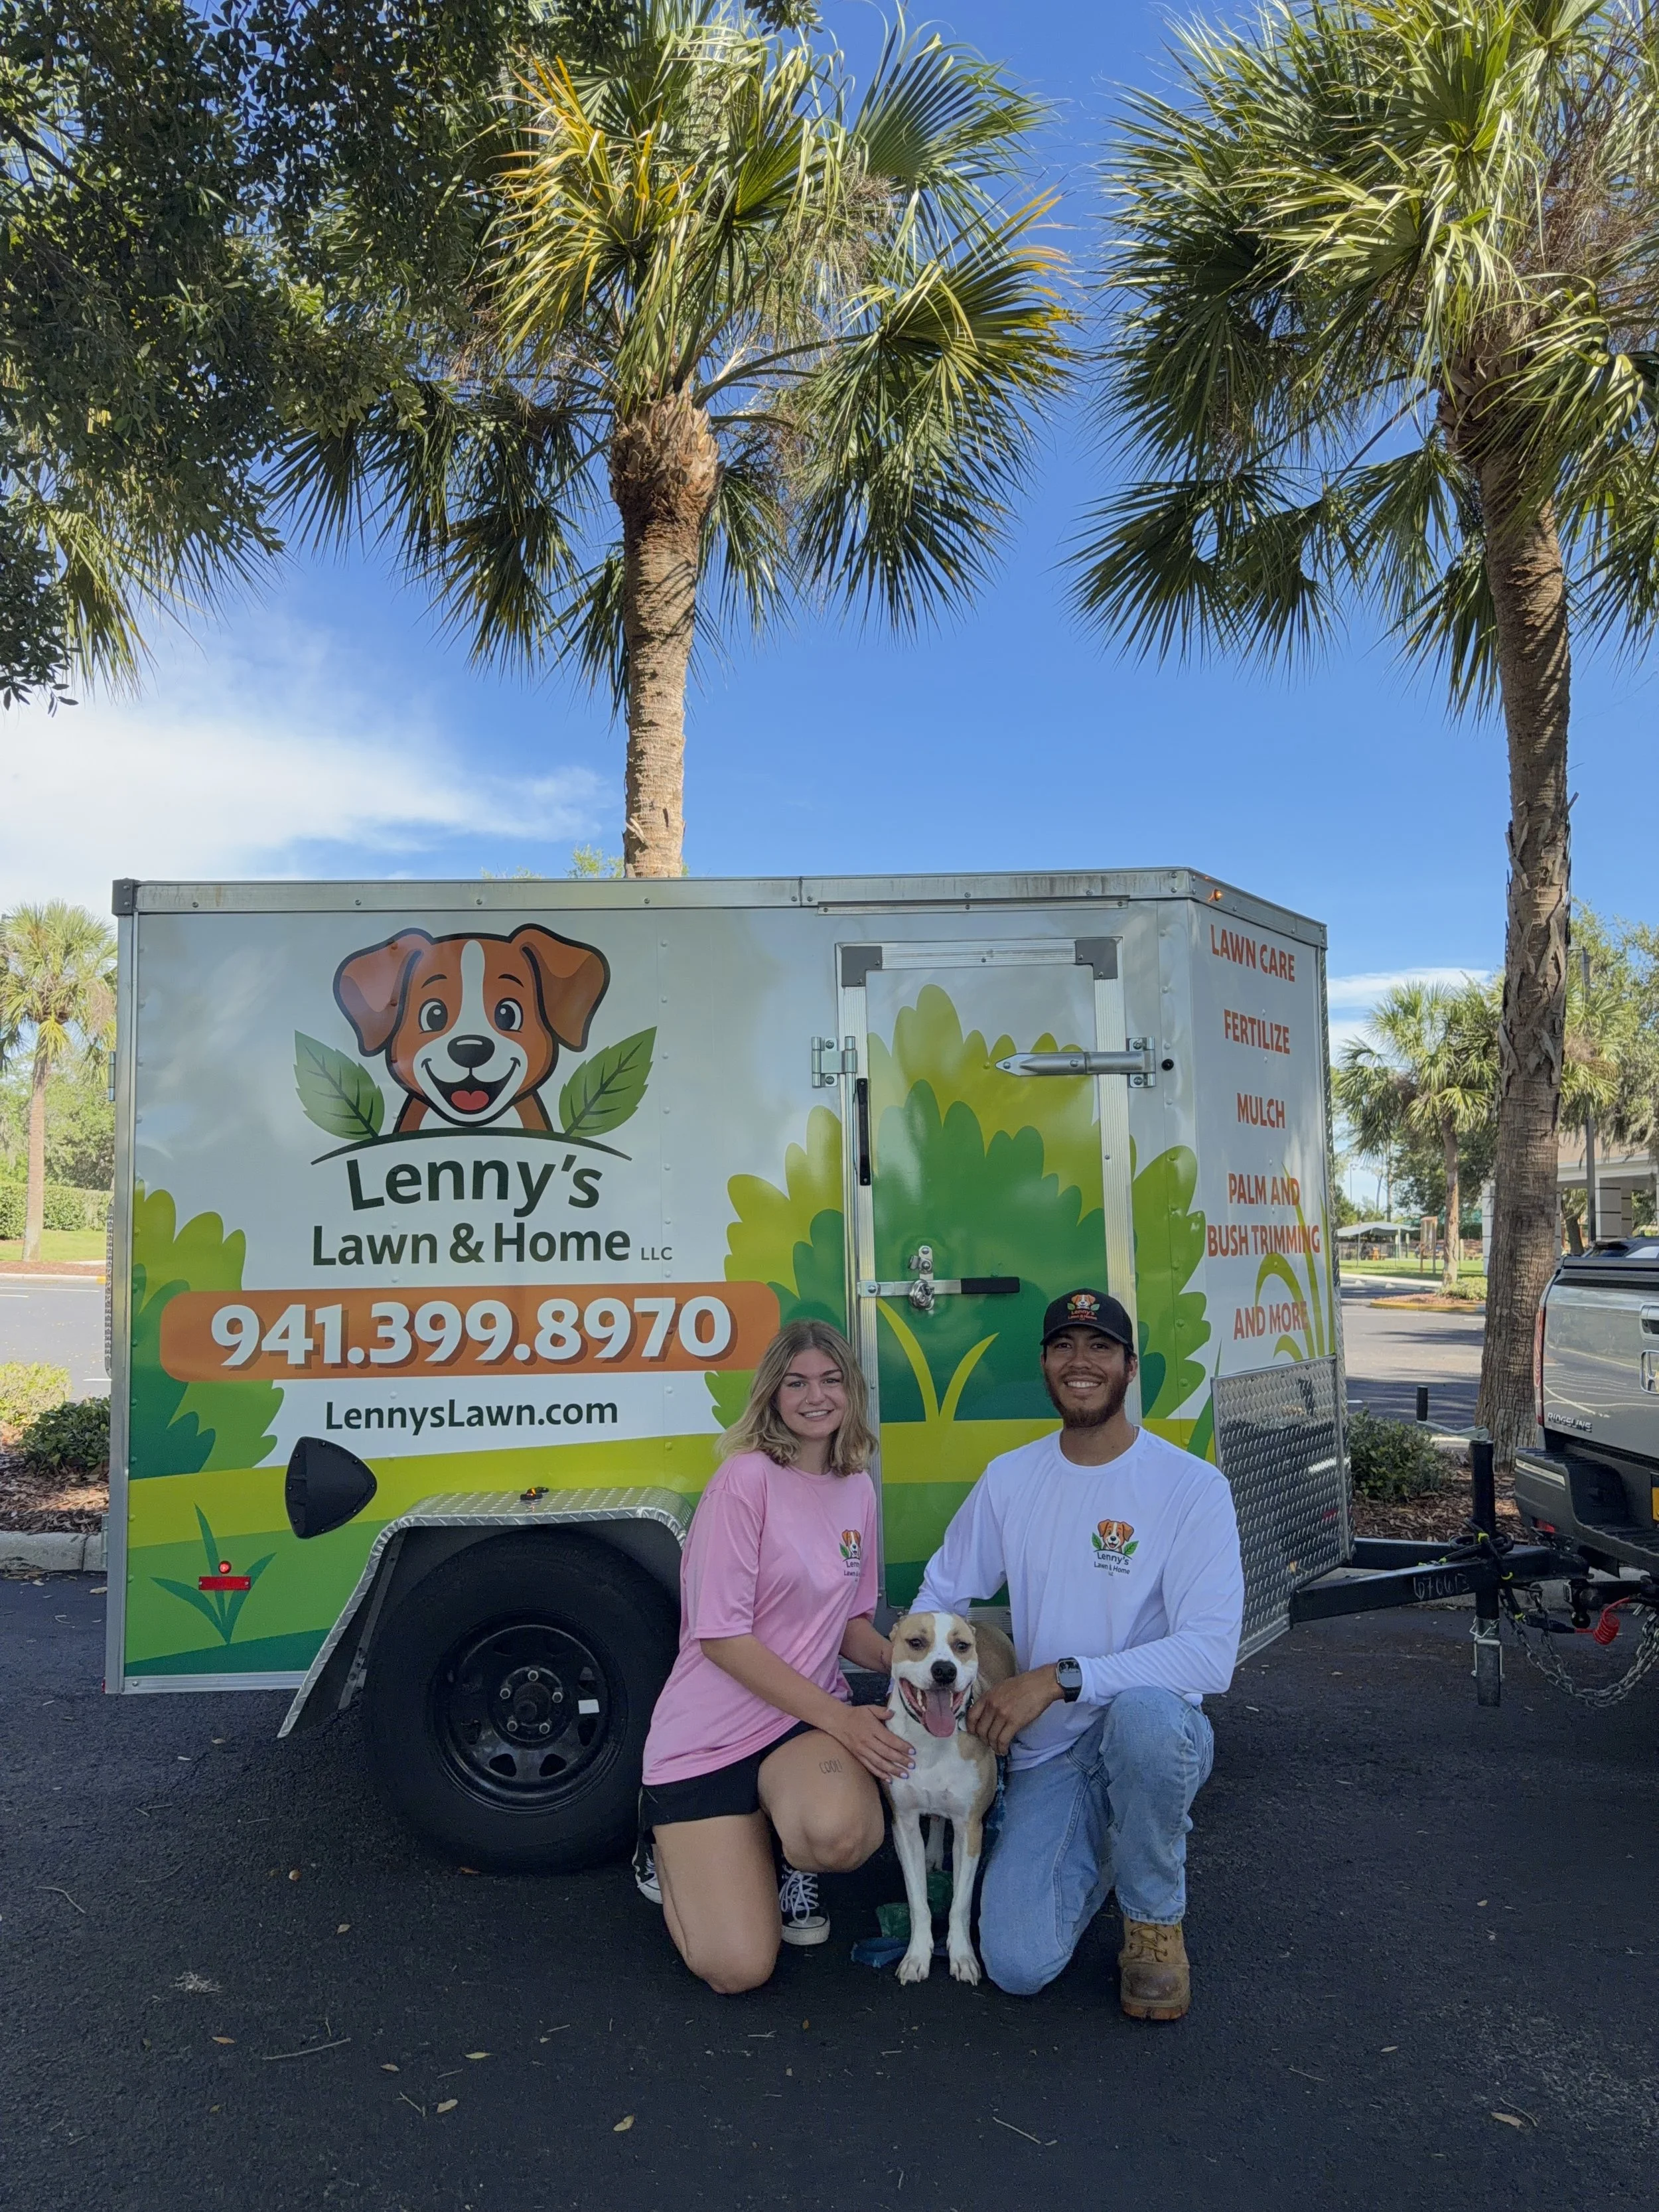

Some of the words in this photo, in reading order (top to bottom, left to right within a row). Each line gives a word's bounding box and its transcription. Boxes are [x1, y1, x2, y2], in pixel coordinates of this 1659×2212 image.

[1210, 924, 1256, 970] LAWN
[1260, 944, 1295, 982] CARE
[1224, 1009, 1290, 1055] FERTILIZE
[1236, 1092, 1285, 1128] MULCH
[346, 1154, 603, 1217] Lenny's
[1228, 1173, 1267, 1205] PALM
[1271, 1177, 1300, 1205] AND
[313, 1224, 438, 1266] Lawn
[449, 1222, 484, 1263] &
[494, 1222, 631, 1262] Home
[640, 1246, 673, 1261] LLC
[1207, 1224, 1249, 1257] BUSH
[1251, 1224, 1320, 1255] TRIMMING
[211, 1295, 733, 1366] 941.399.8970
[1234, 1305, 1265, 1340] AND
[1269, 1301, 1308, 1334] MORE
[325, 1399, 618, 1436] LennysLawn.com
[1548, 1412, 1593, 1433] RIDGELINE
[1097, 1552, 1129, 1566] Lenny's
[1113, 1565, 1131, 1575] Home
